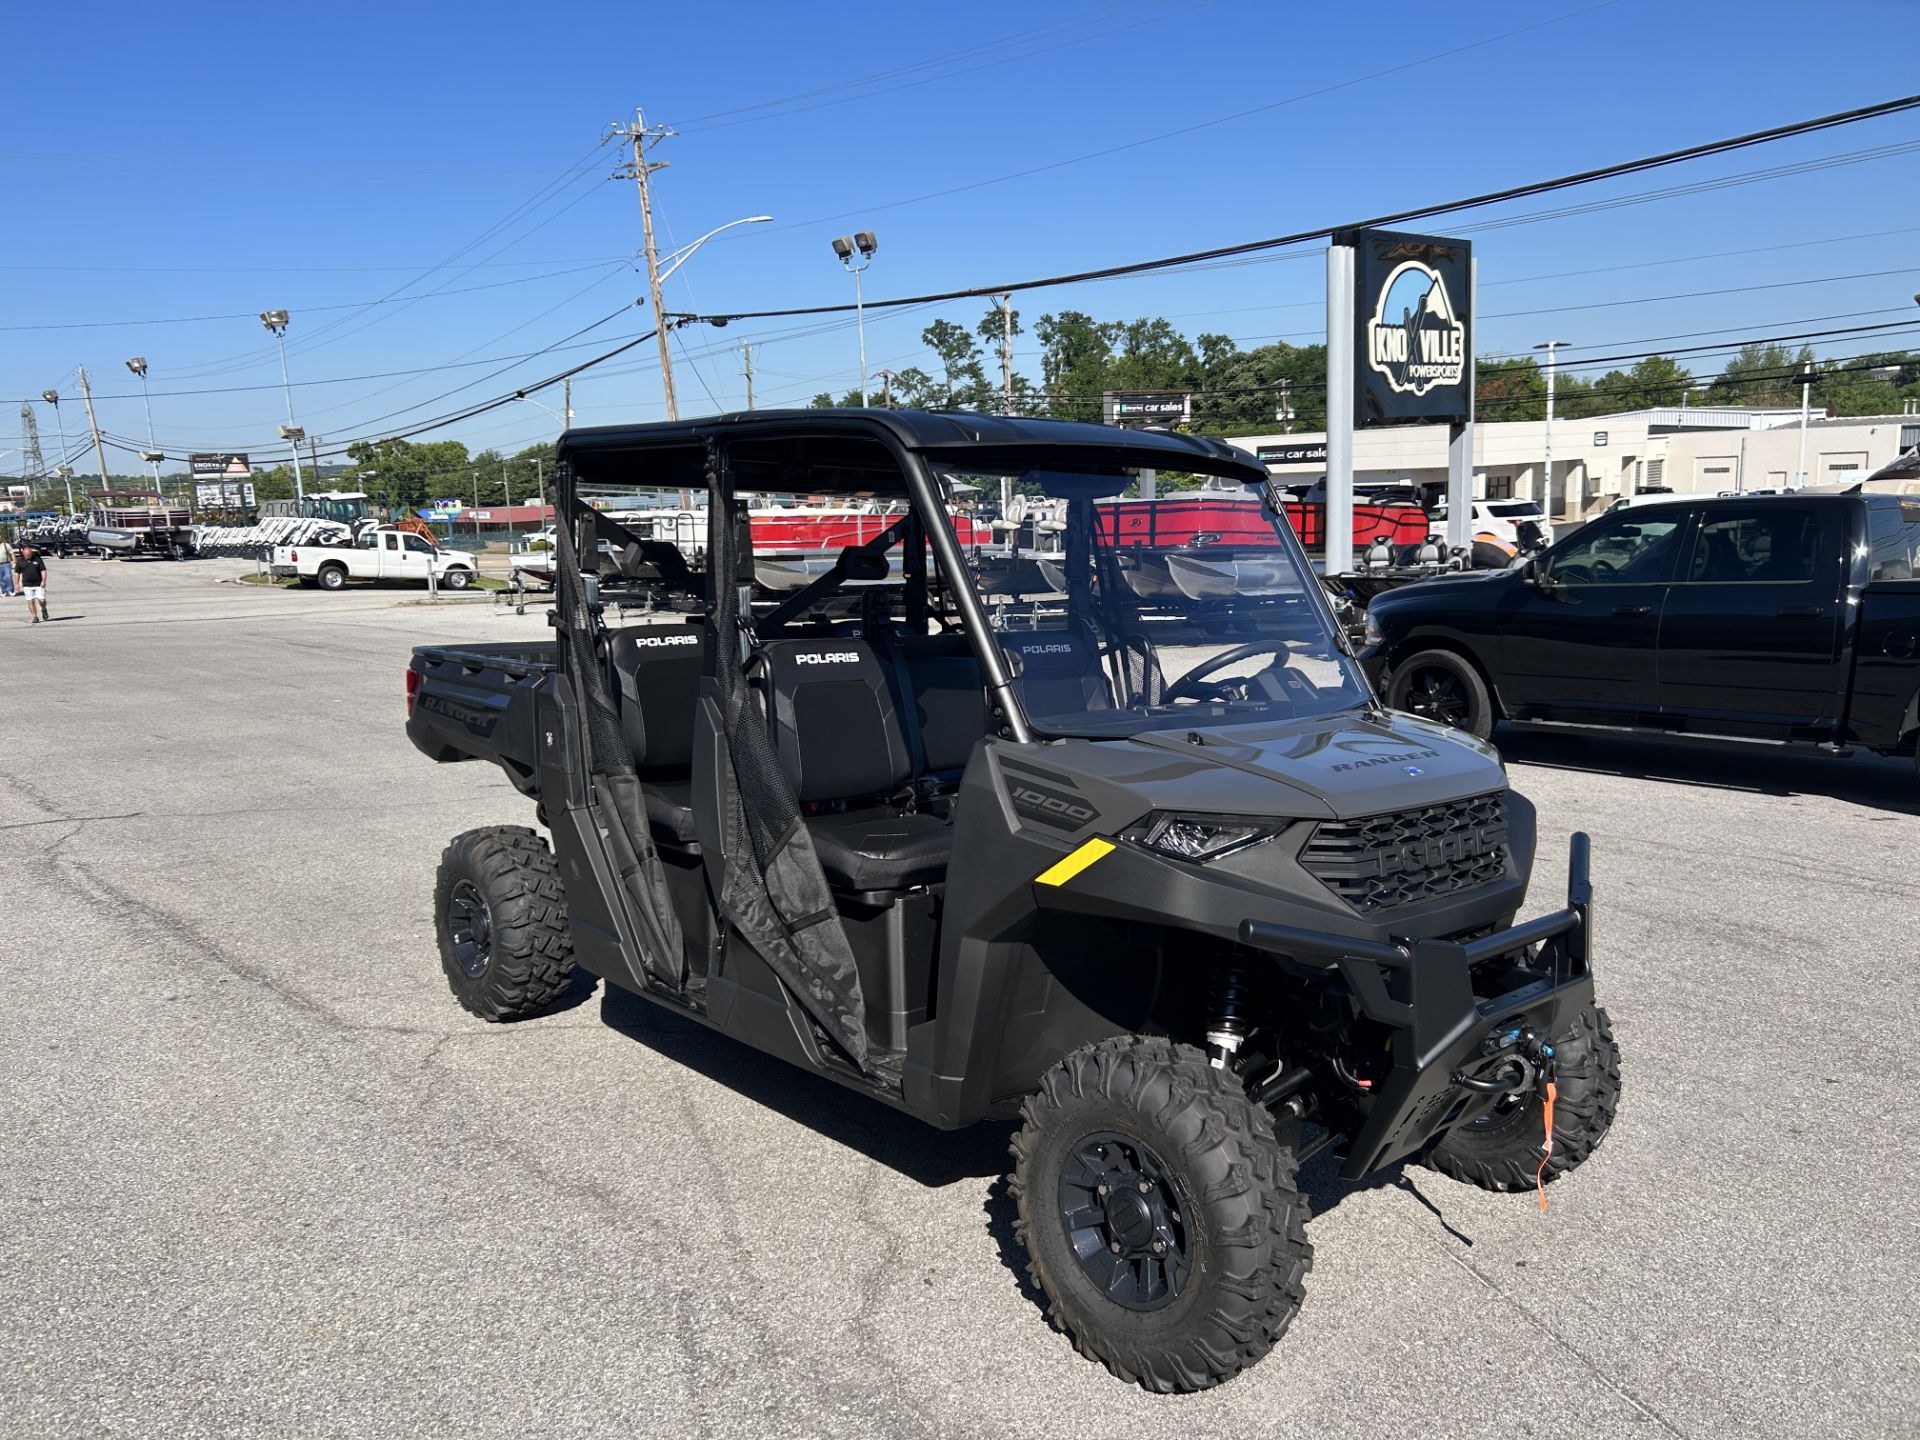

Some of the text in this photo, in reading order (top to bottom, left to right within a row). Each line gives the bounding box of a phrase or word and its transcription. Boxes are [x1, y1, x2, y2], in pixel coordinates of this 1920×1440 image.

[1409, 365, 1458, 378] POWERSPORTS
[1144, 403, 1159, 412] car
[1160, 401, 1183, 412] sales
[1286, 450, 1304, 459] car
[1306, 447, 1327, 458] sale
[635, 635, 698, 648] POLARIS
[1022, 644, 1072, 654] POLARIS
[795, 652, 859, 665] POLARIS
[424, 696, 492, 729] RANGER
[1330, 750, 1441, 773] RANGER
[1011, 786, 1094, 820] 1000
[1378, 827, 1508, 877] POLARIS
